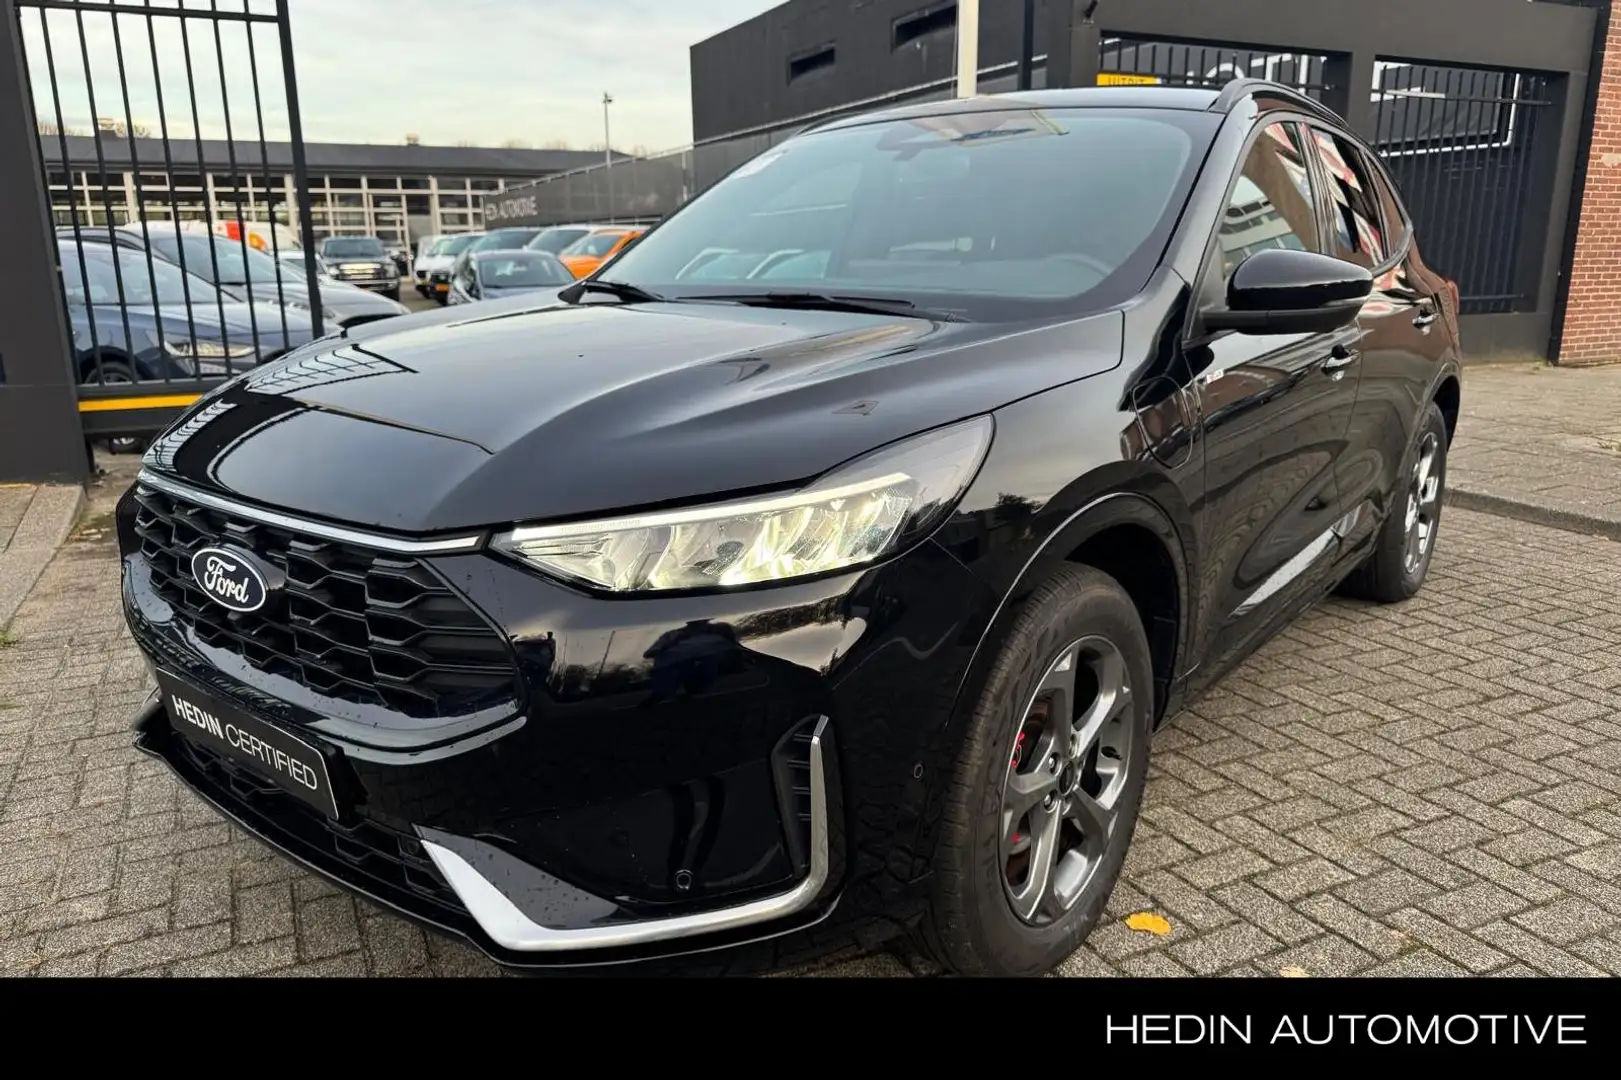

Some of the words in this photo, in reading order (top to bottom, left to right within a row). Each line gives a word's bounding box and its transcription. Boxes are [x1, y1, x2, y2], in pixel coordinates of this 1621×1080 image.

[204, 556, 249, 603] Ford
[172, 694, 224, 740] HEDIN
[225, 723, 318, 790] CERTIFIED
